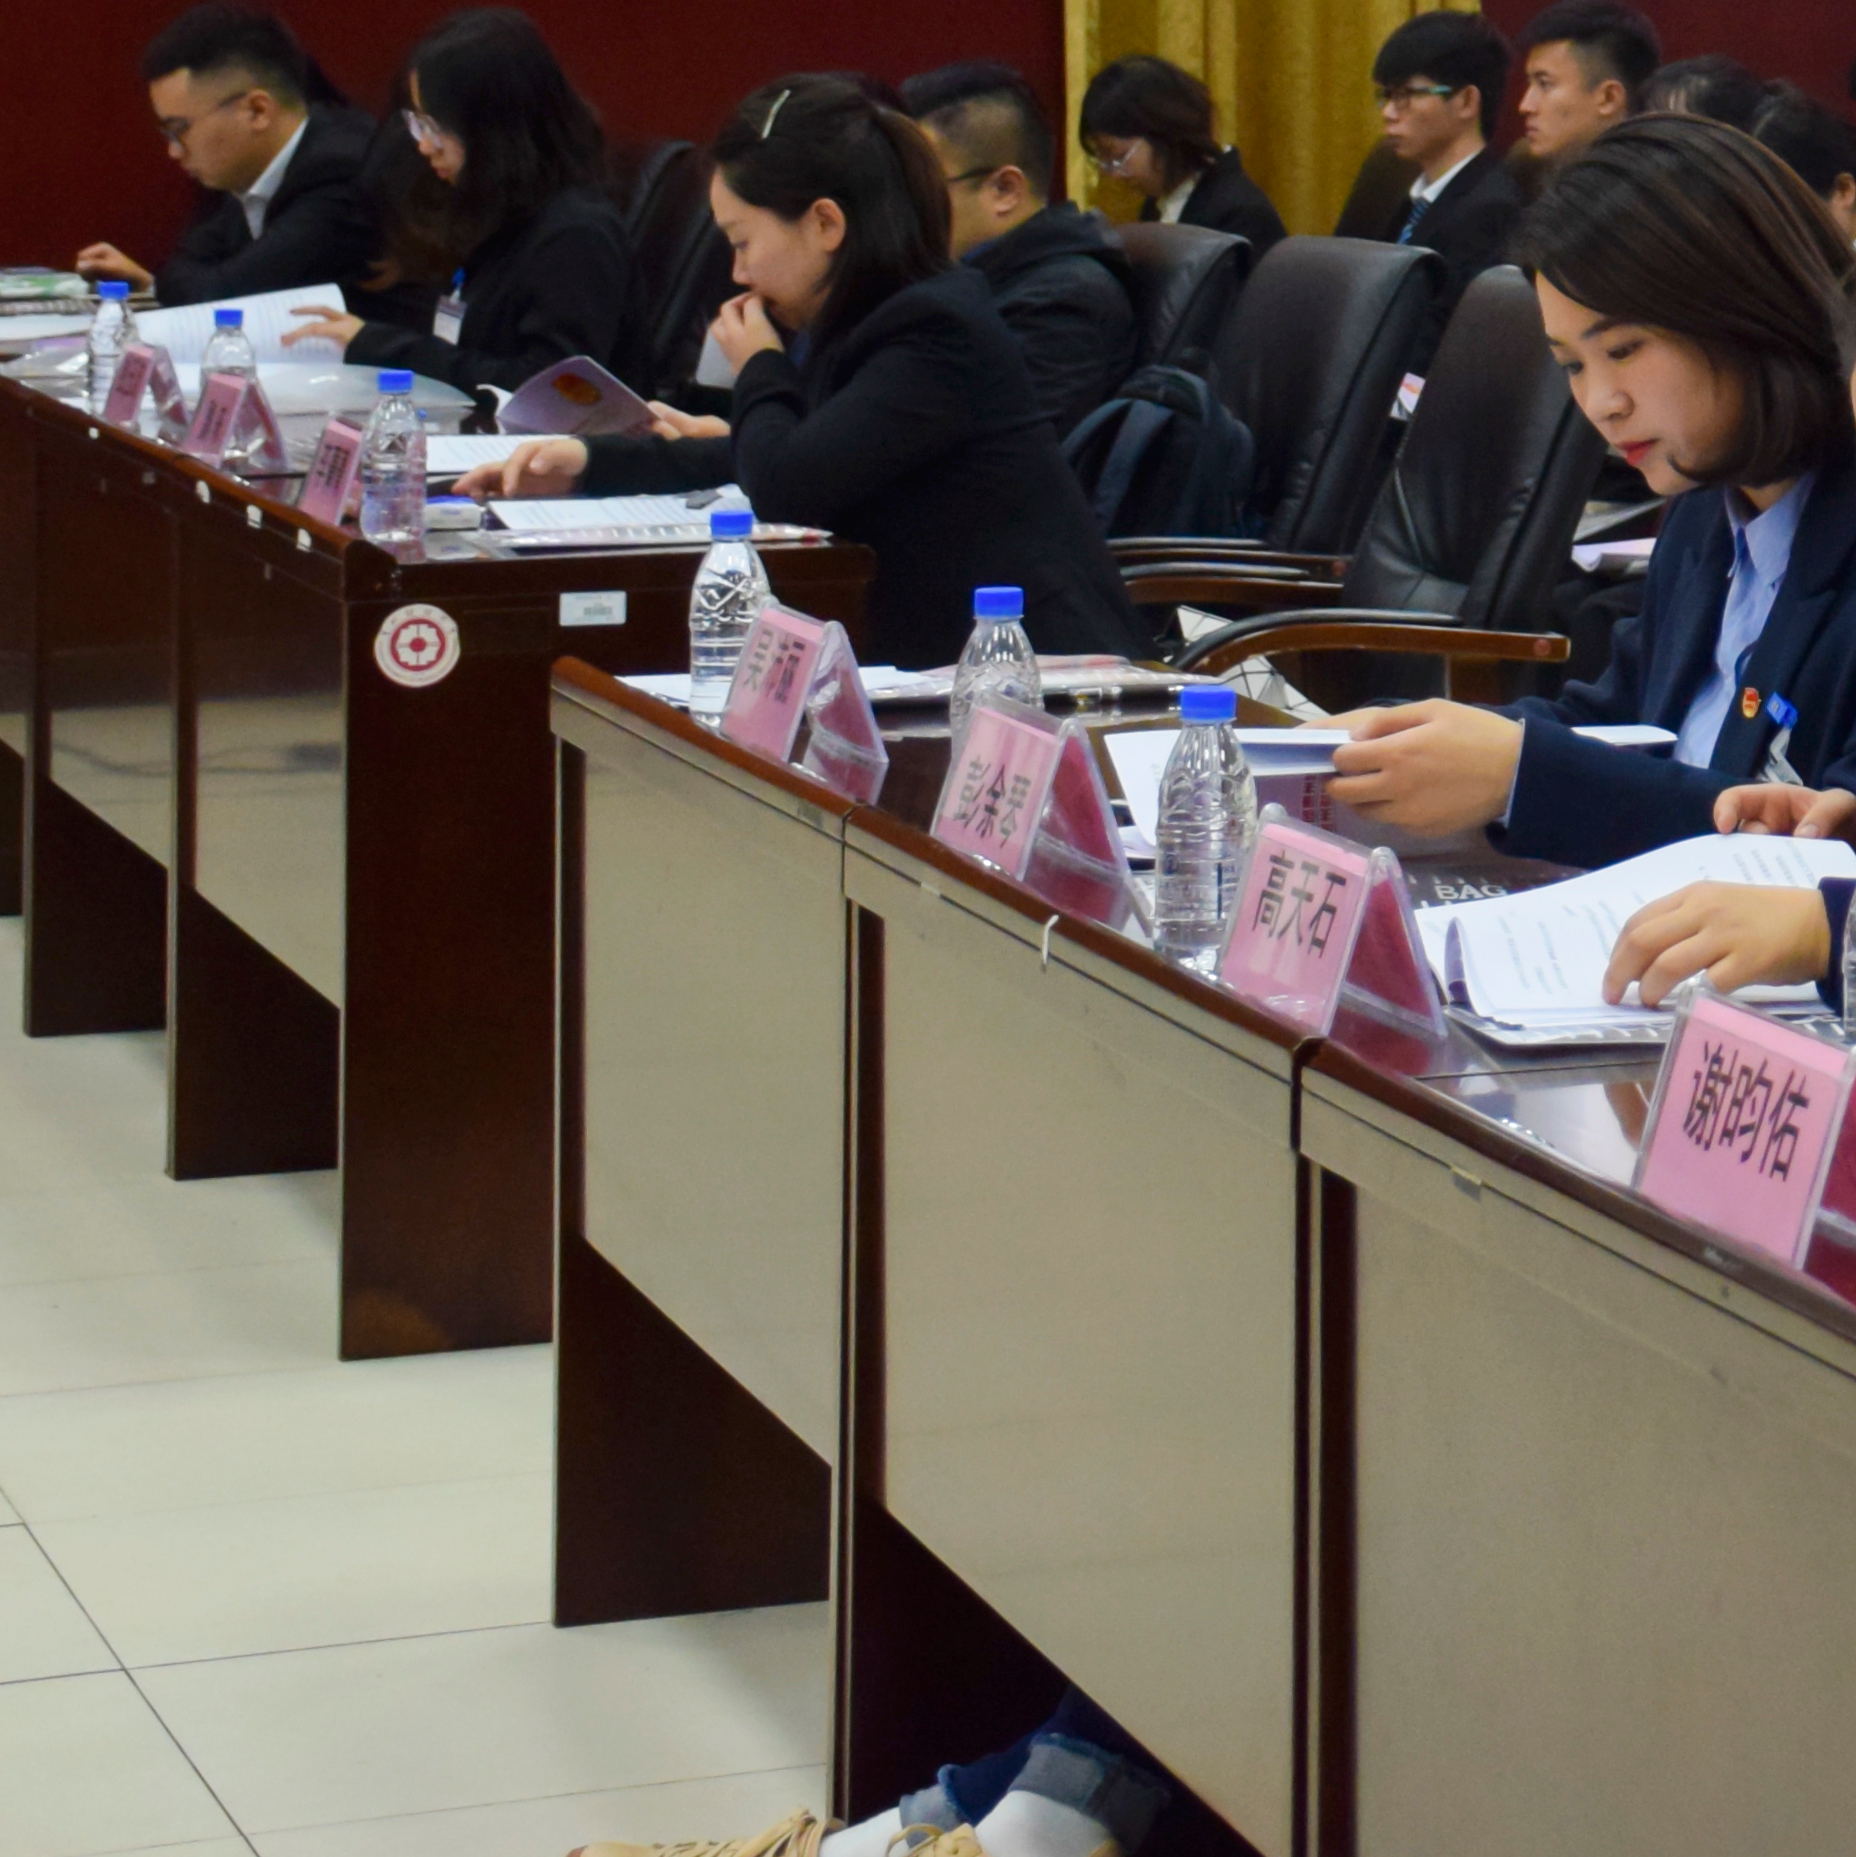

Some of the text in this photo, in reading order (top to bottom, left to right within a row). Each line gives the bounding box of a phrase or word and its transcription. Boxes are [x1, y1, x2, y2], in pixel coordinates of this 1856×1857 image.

[953, 755, 1032, 848] 彭余琴
[1252, 850, 1347, 959] 高天石
[1683, 1040, 1810, 1182] 谢昀佑
